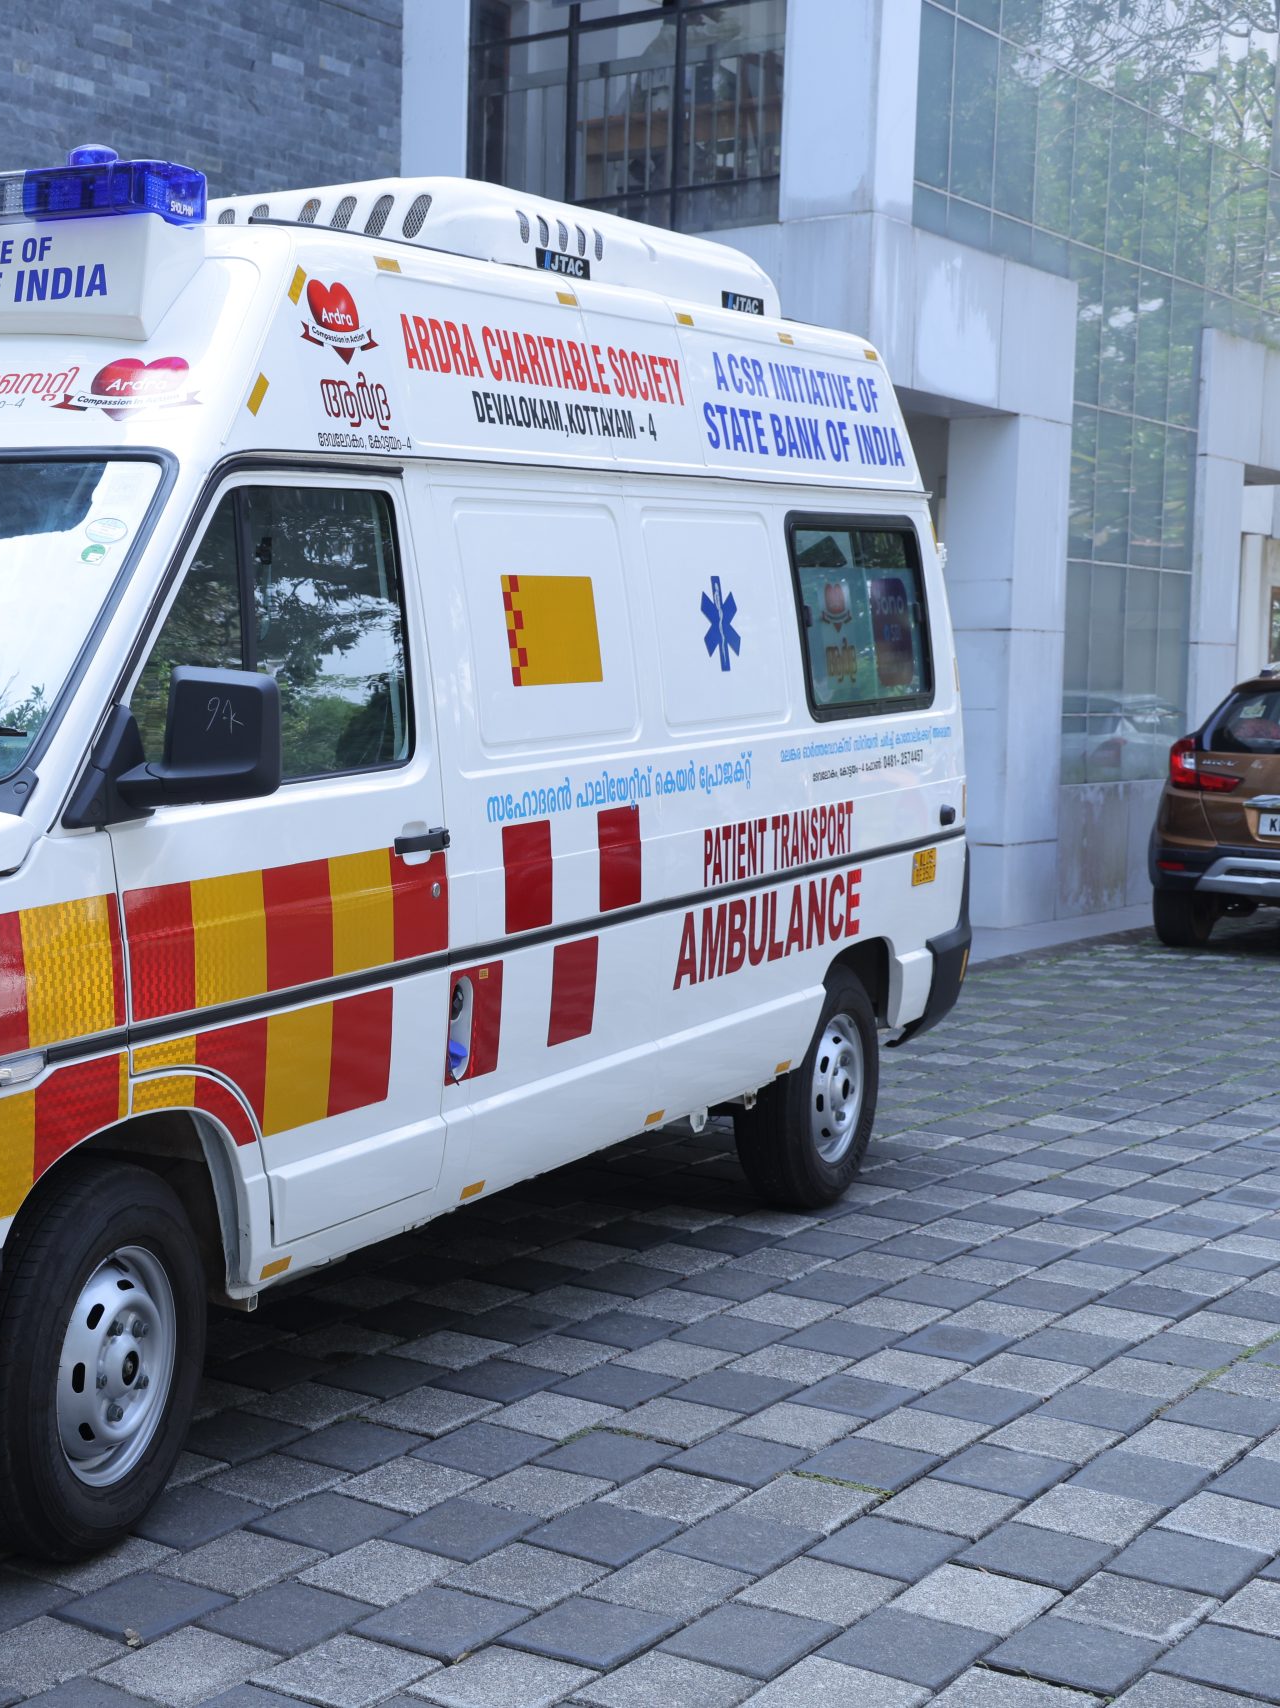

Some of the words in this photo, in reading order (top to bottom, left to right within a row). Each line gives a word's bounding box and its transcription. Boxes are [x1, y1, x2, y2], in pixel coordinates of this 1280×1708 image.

[21, 236, 53, 263] OF
[550, 254, 584, 278] JTAC
[13, 263, 108, 303] INDIA
[321, 307, 354, 327] Ardra
[732, 296, 759, 315] JTAC
[311, 325, 344, 343] Compassion
[350, 332, 366, 343] Action
[400, 313, 484, 378] ARDRA
[481, 325, 612, 395] CHARITABLE
[606, 345, 686, 406] SOCIETY
[77, 395, 133, 407] Compassion
[320, 371, 391, 431] ആർദ്ര
[712, 351, 730, 392] A
[727, 353, 769, 398] CSR
[768, 361, 858, 412] INITIATIVE
[856, 376, 879, 414] OF
[471, 390, 637, 440] DEVALOKAM,KOTTAYAM
[648, 413, 658, 441] 4
[703, 401, 769, 455] STATE
[769, 413, 827, 461] BANK
[825, 419, 850, 462] OF
[853, 423, 906, 467] INDIA
[655, 760, 696, 794] കെയർ
[704, 817, 768, 888] PATIENT
[771, 800, 854, 871] TRANSPORT
[672, 868, 862, 991] AMBULANCE
